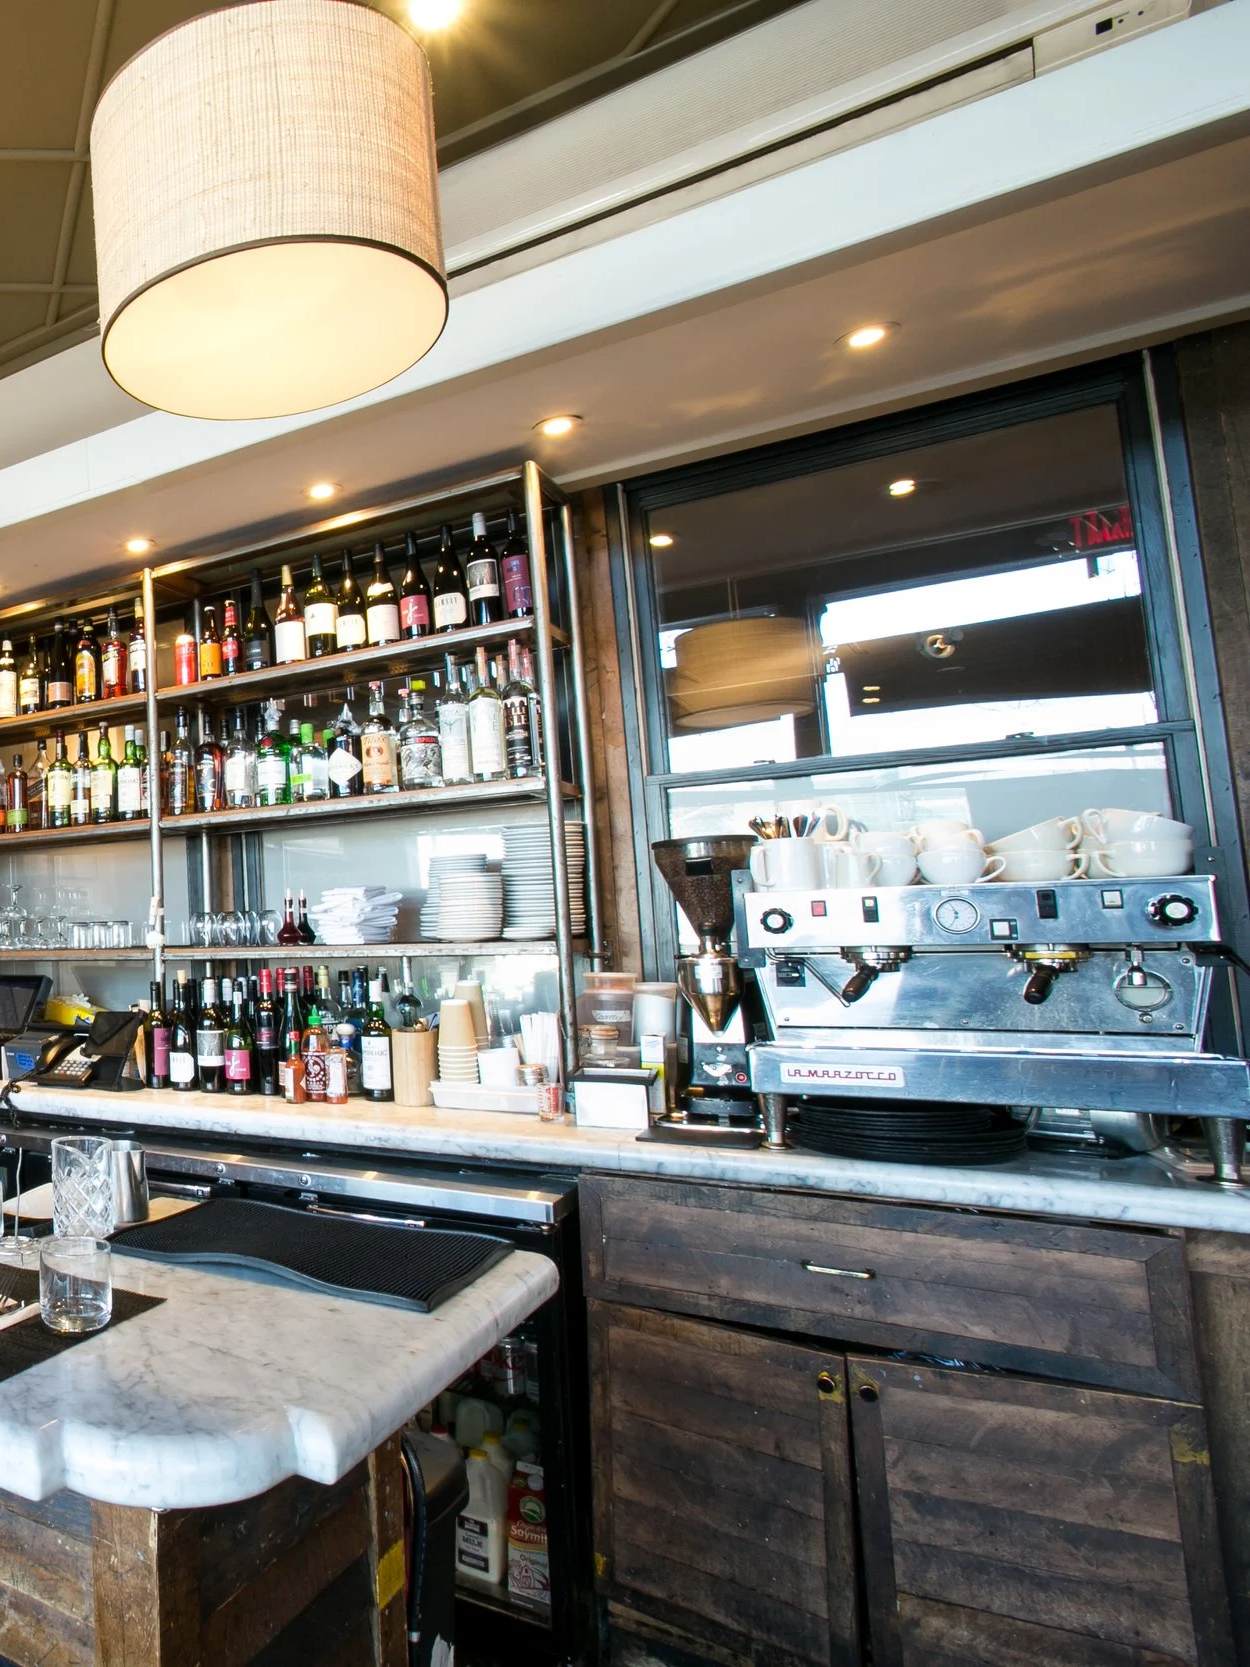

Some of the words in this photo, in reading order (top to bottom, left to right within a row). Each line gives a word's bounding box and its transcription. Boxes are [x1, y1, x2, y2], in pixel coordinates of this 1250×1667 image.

[787, 1068, 802, 1077] LA
[807, 1069, 897, 1081] MARZOCCO
[511, 1525, 548, 1545] Soymil
